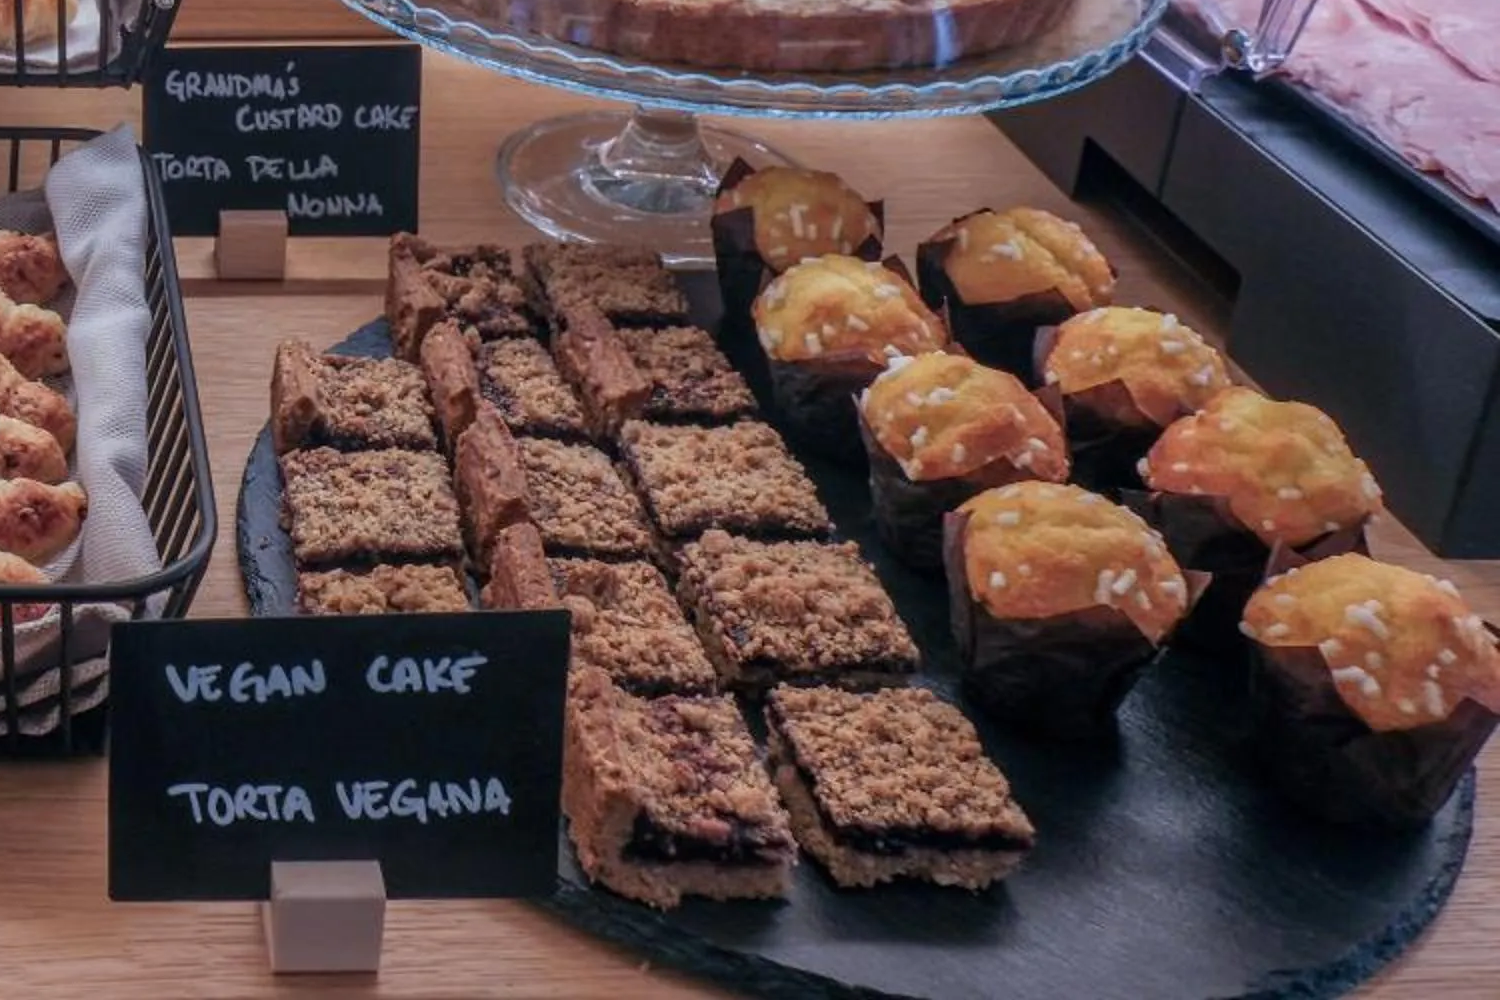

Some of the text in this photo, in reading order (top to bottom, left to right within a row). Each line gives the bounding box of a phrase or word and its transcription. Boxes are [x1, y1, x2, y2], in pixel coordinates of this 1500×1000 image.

[236, 103, 419, 132] CUSTARD CAKE
[152, 152, 338, 182] TORTA DELLA
[288, 193, 383, 218] NONNA
[166, 655, 488, 702] VEGAN CAKE
[168, 778, 511, 826] TORTA VEGANA
